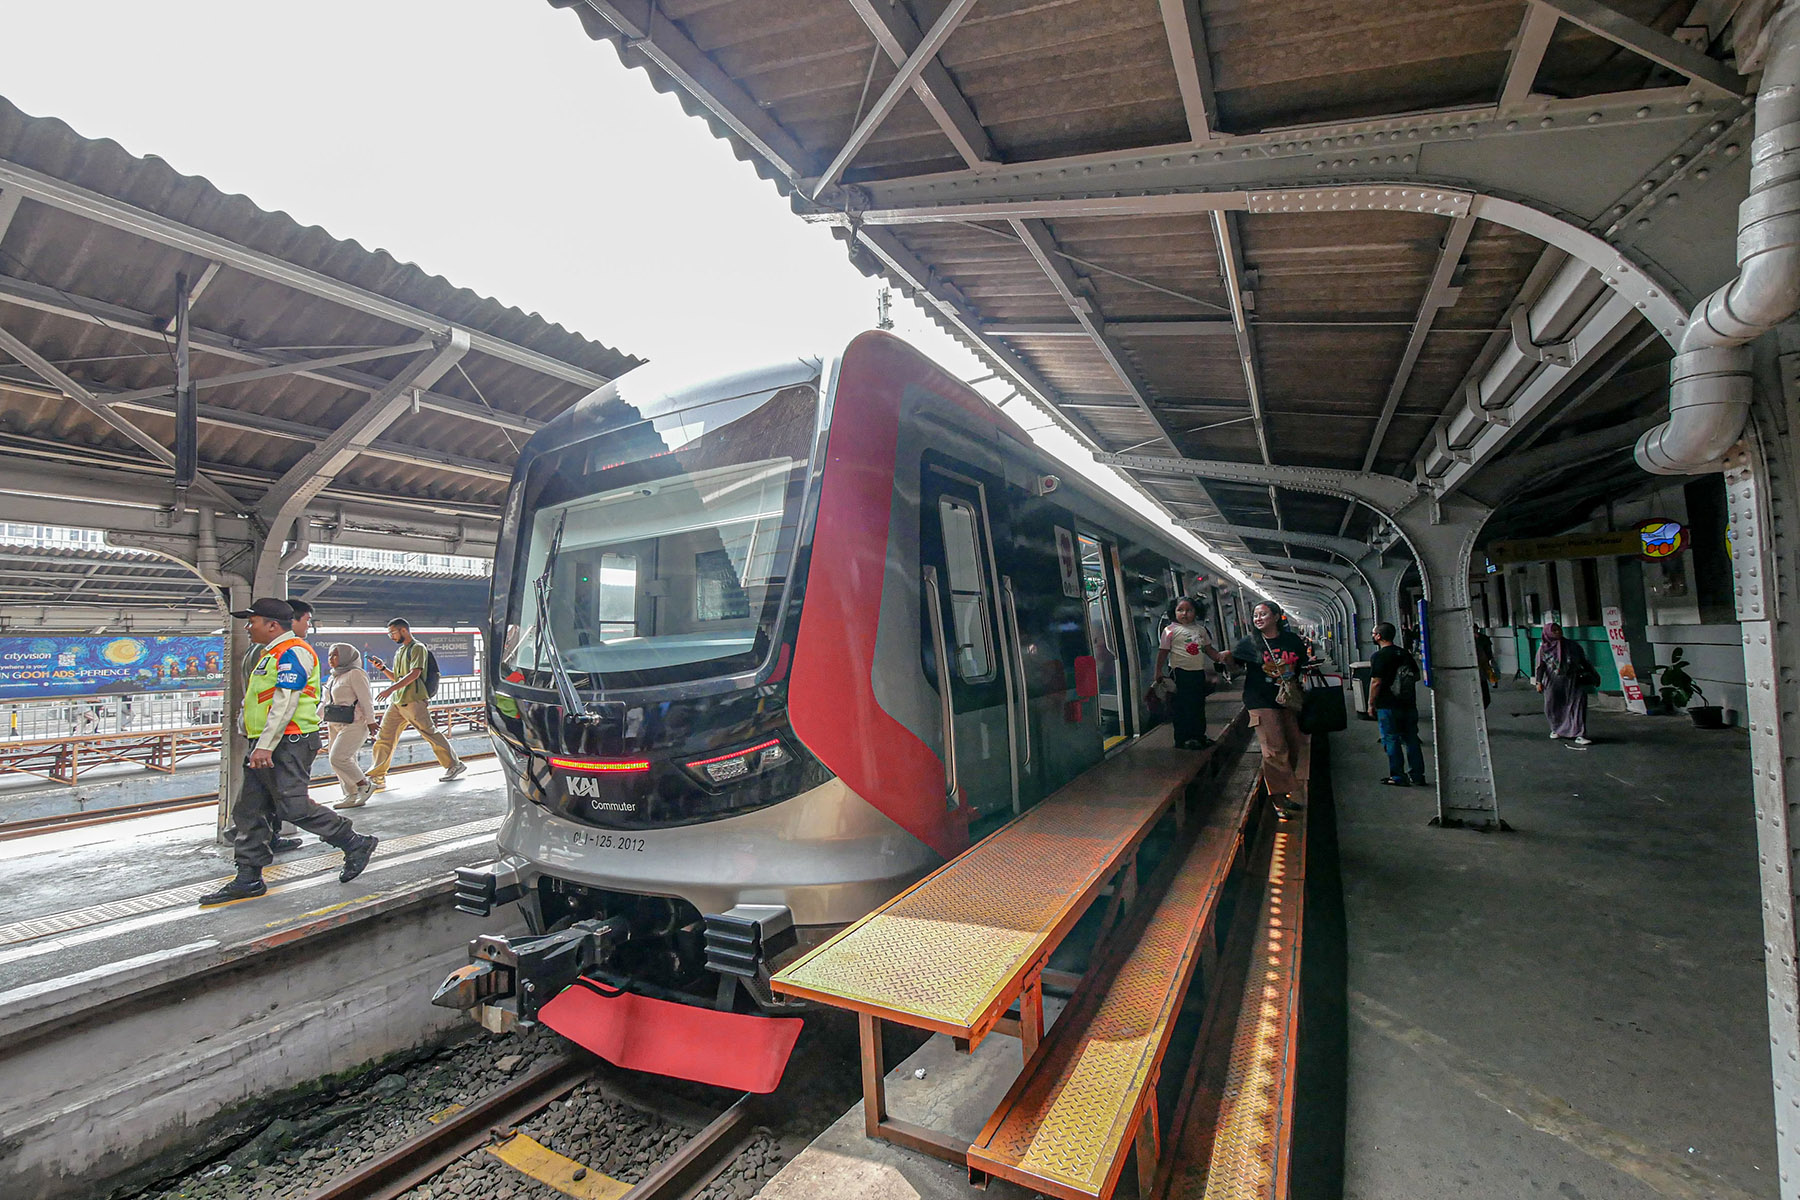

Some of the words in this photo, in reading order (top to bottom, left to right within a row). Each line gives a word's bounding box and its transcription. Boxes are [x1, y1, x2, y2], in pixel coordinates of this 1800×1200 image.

[4, 652, 52, 661] cityvision
[52, 668, 130, 678] ADS-PERIENCE
[566, 775, 600, 798] KAI
[591, 800, 636, 812] Commuter
